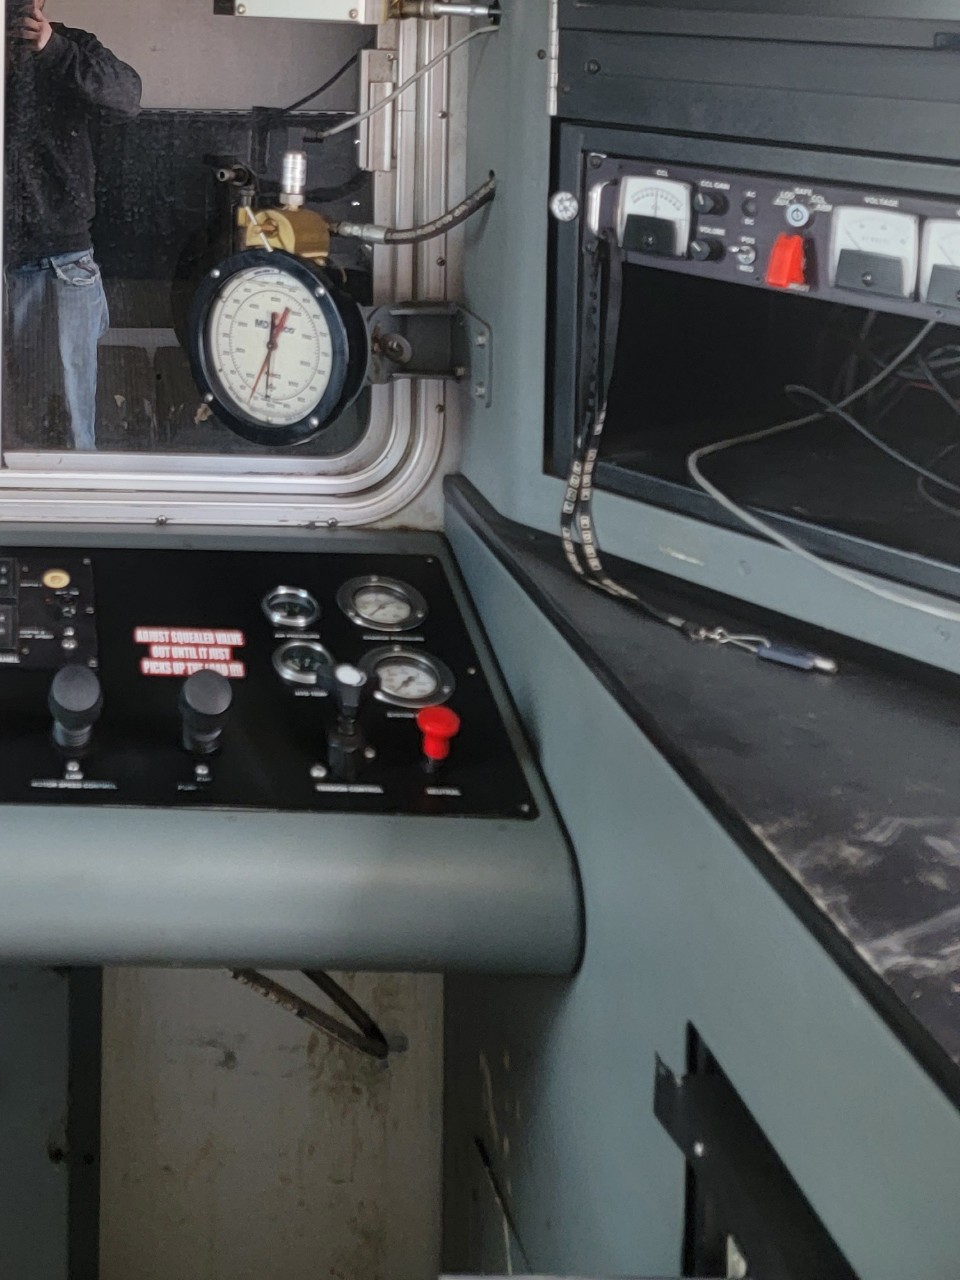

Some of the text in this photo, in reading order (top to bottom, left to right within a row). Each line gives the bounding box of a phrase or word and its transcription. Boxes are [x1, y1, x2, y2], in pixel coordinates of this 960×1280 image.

[136, 628, 244, 646] ADJUST SQUEALER VALVE
[151, 645, 231, 660] OUT UNTIL IT JUST
[142, 659, 172, 674] PICKS
[172, 661, 186, 674] UP
